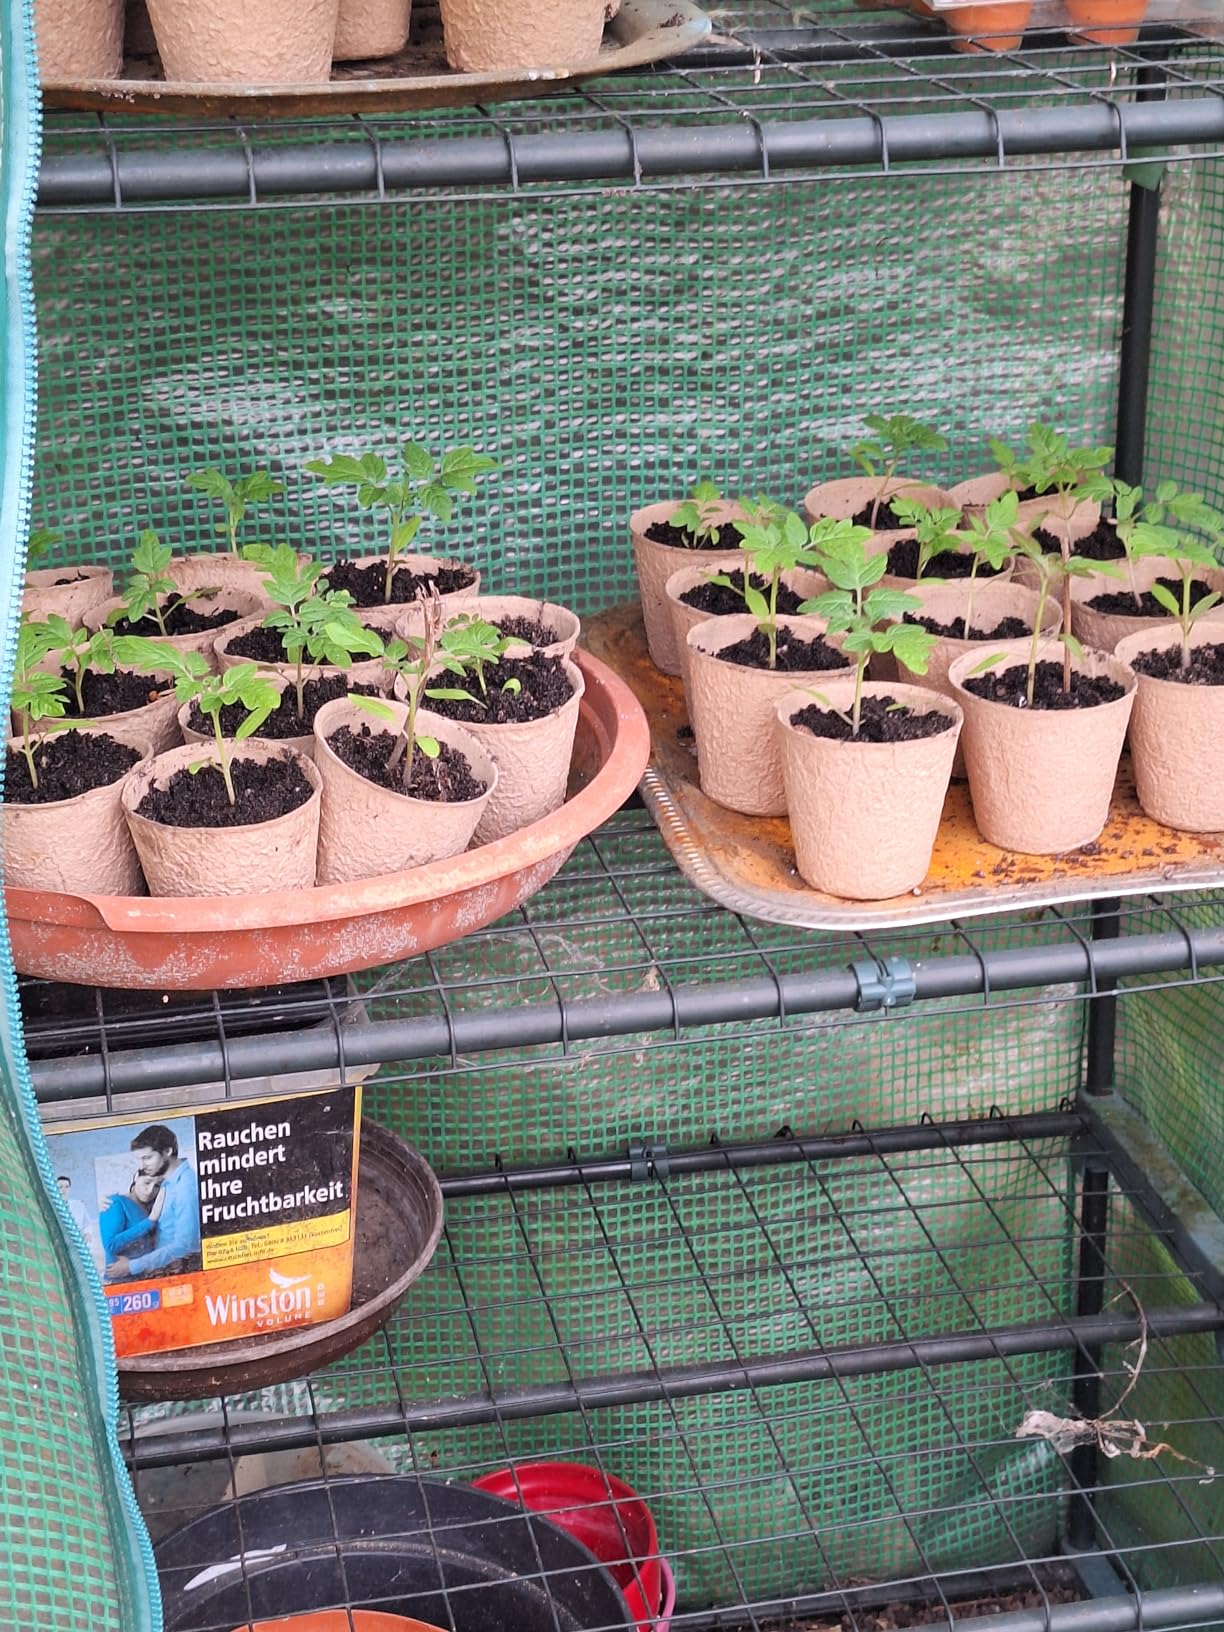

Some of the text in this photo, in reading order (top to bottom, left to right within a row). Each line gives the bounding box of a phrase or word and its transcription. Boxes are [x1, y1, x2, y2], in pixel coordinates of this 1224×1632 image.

[198, 1120, 291, 1151] Rauchen
[199, 1145, 286, 1176] mindert
[200, 1179, 243, 1200] Ihre
[201, 1181, 344, 1224] Fruchtbarkeit
[123, 1293, 152, 1312] 260
[204, 1287, 311, 1326] Winston
[256, 1311, 313, 1328] VOLUME
